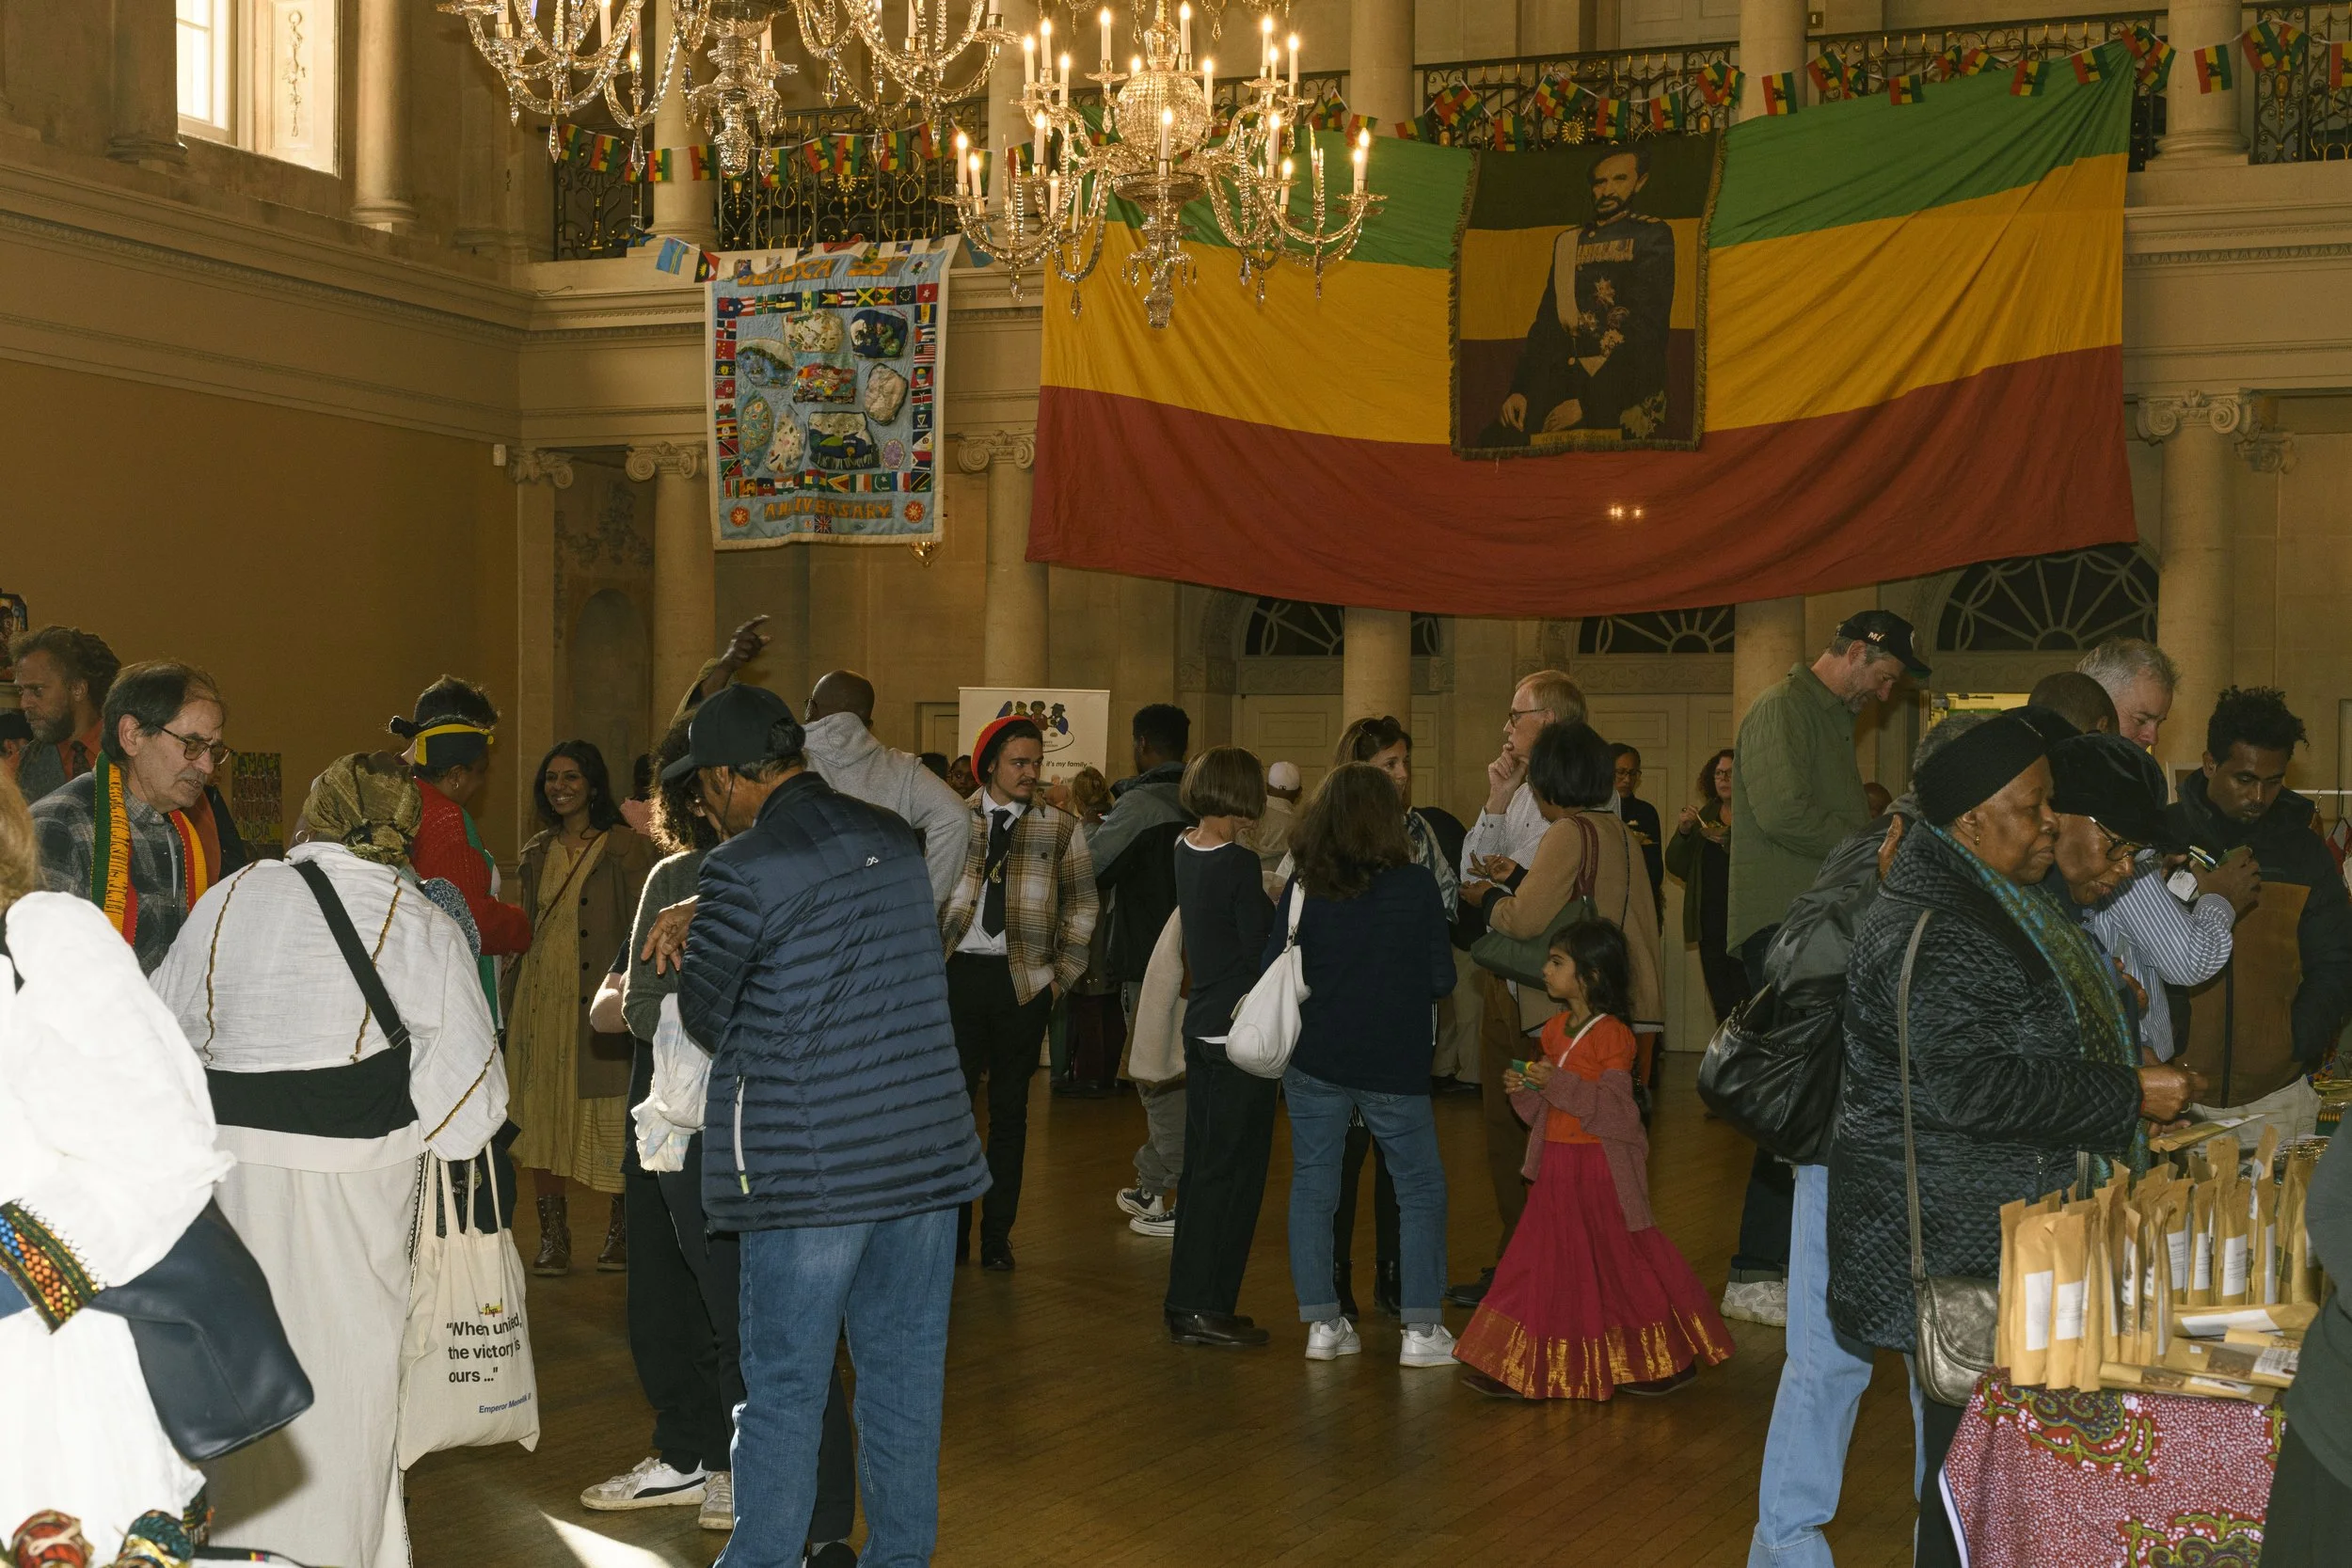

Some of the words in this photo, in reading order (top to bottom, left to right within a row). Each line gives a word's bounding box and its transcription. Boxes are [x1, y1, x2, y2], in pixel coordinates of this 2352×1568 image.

[493, 1313, 522, 1334] unied,
[448, 1344, 469, 1360] the
[472, 1343, 514, 1358] victory
[514, 1337, 520, 1352] is
[449, 1370, 481, 1384] ours
[479, 1402, 508, 1414] Emperor
